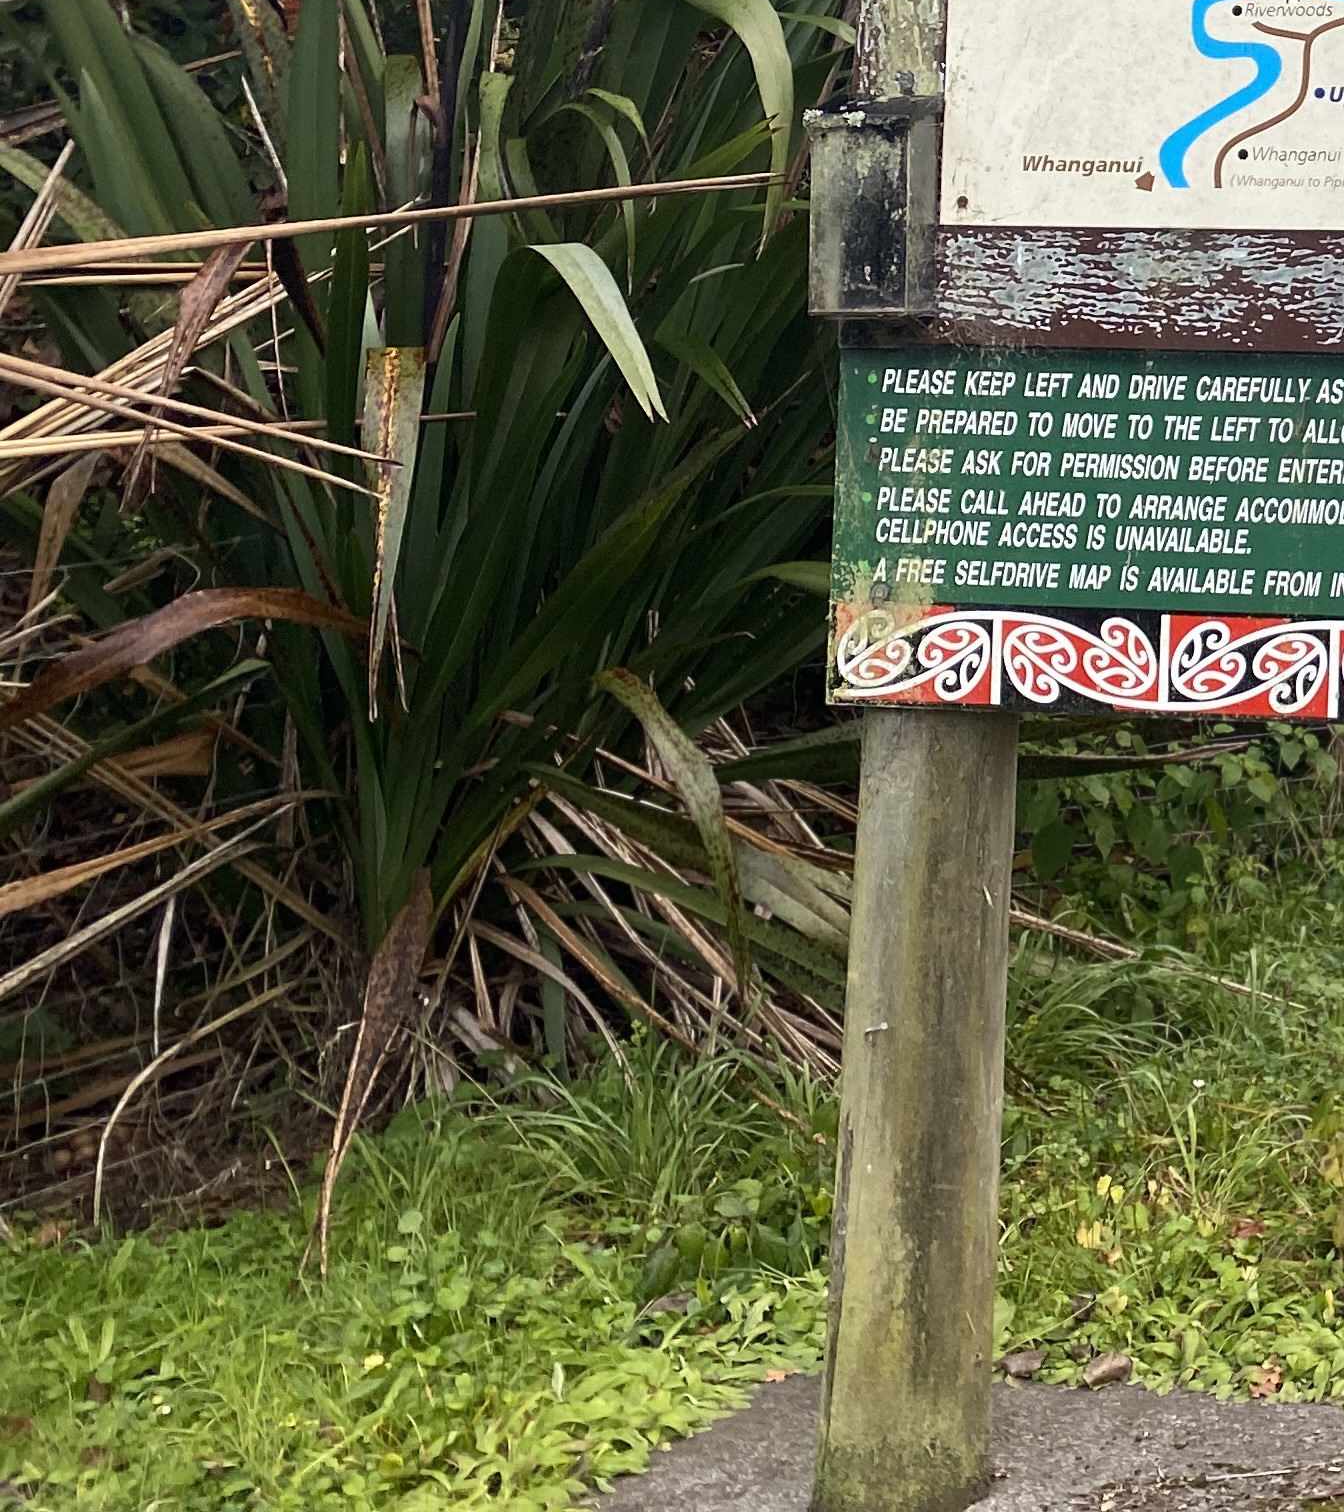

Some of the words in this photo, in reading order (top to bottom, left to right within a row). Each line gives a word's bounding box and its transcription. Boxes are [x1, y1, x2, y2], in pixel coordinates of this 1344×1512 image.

[1245, 2, 1333, 17] Riverwoods
[1022, 156, 1144, 175] Whanganui
[1252, 147, 1342, 165] Whanganui
[882, 370, 957, 395] PLEASE
[965, 372, 1016, 396] KEEP
[1023, 373, 1072, 398] LEFT
[1078, 374, 1120, 399] AND
[1128, 375, 1187, 401] DRIVE
[1197, 376, 1311, 403] CAREFULLY
[1316, 378, 1344, 404] AS
[876, 488, 951, 515] PLEASE
[961, 490, 1009, 516] CALL
[1020, 492, 1086, 517] AHEAD
[1096, 494, 1121, 518] TO
[1128, 496, 1227, 522] ARRANGE
[875, 519, 990, 546] CELLPHONE
[998, 522, 1077, 549] ACCESS
[1086, 525, 1106, 549] IS
[1115, 526, 1252, 555] UNAVAILABLE.
[873, 558, 888, 582] A
[895, 559, 946, 584] FREE
[955, 561, 1062, 588] SELFDRIVE
[1069, 565, 1111, 590] MAP
[1119, 566, 1139, 592] IS
[1147, 567, 1255, 595] AVAILABLE
[1263, 571, 1323, 597] FROM
